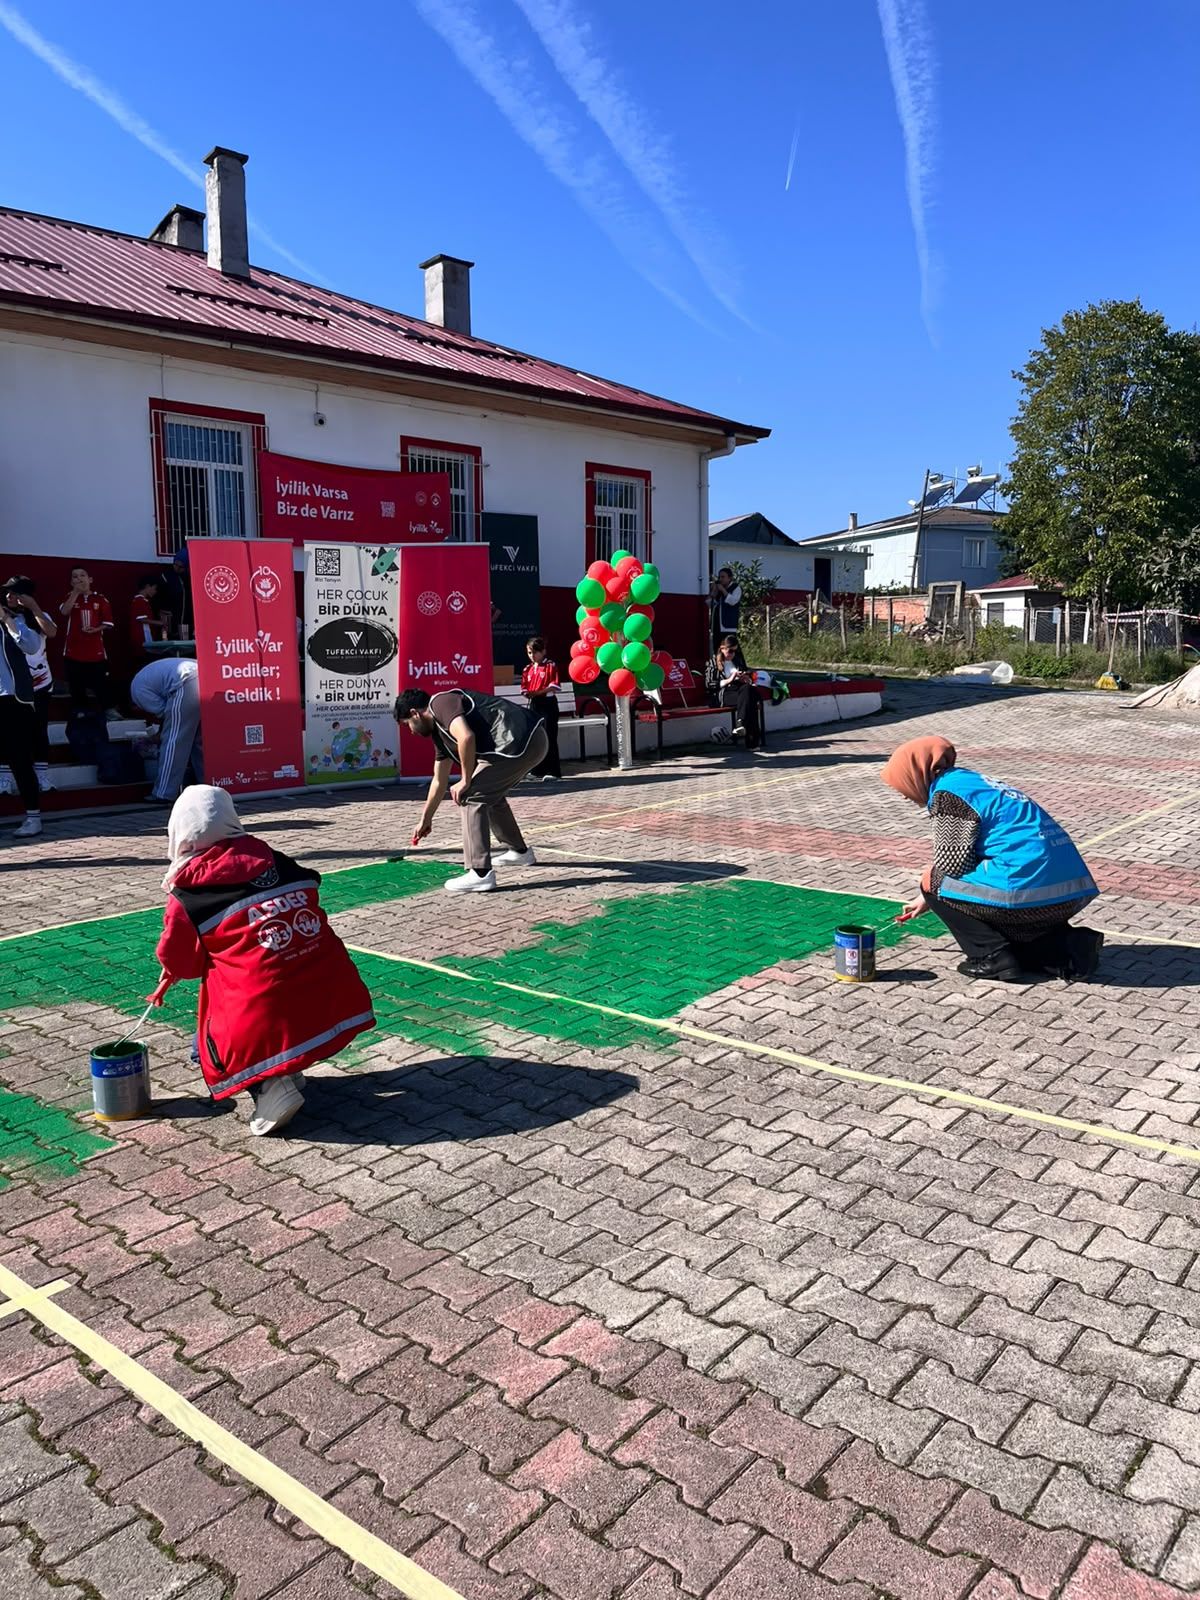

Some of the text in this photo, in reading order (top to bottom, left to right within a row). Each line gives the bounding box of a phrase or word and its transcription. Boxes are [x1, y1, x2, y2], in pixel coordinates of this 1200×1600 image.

[276, 476, 348, 500] İyilik Varsa
[277, 501, 354, 521] Biz de Varız
[317, 589, 389, 603] HER ÇOCUK
[318, 602, 387, 616] BİR DÜNYA
[215, 630, 283, 657] İyilik Var
[221, 663, 280, 679] Dediler;
[408, 653, 481, 679] İyilik Var
[319, 677, 386, 690] HER DÜNYA
[224, 687, 273, 704] Geldik
[325, 690, 381, 702] BİR UMUT
[329, 704, 350, 712] ÇOCUK
